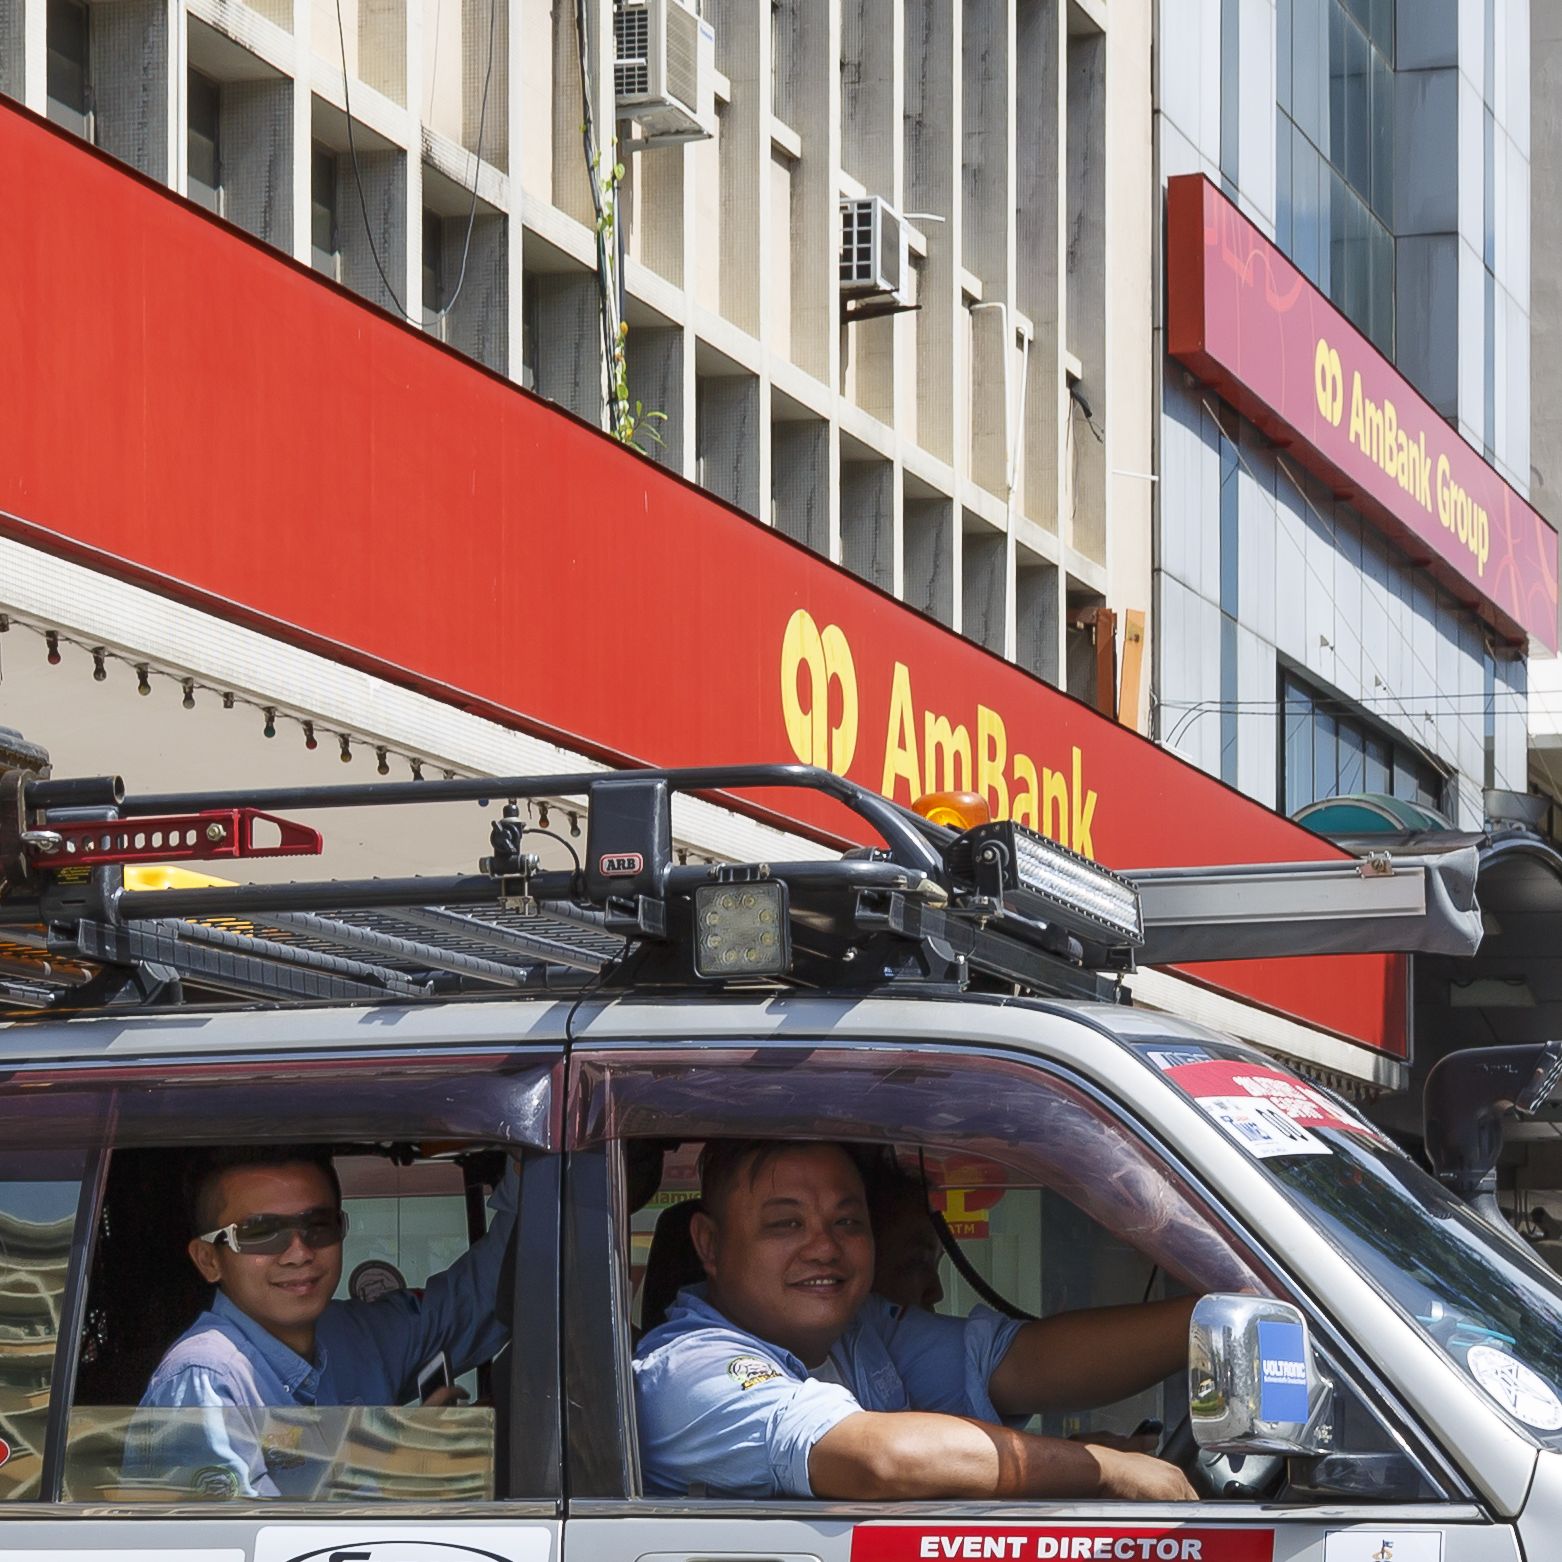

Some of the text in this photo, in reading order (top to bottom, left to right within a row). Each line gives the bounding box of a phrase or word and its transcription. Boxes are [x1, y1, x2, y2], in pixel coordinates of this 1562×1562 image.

[1350, 370, 1489, 577] AmBank Group
[881, 660, 1097, 861] AmBank
[606, 858, 636, 871] ARB
[1263, 1360, 1306, 1378] VOLTRONIC
[919, 1536, 1203, 1561] EVENT DIRECTOR
